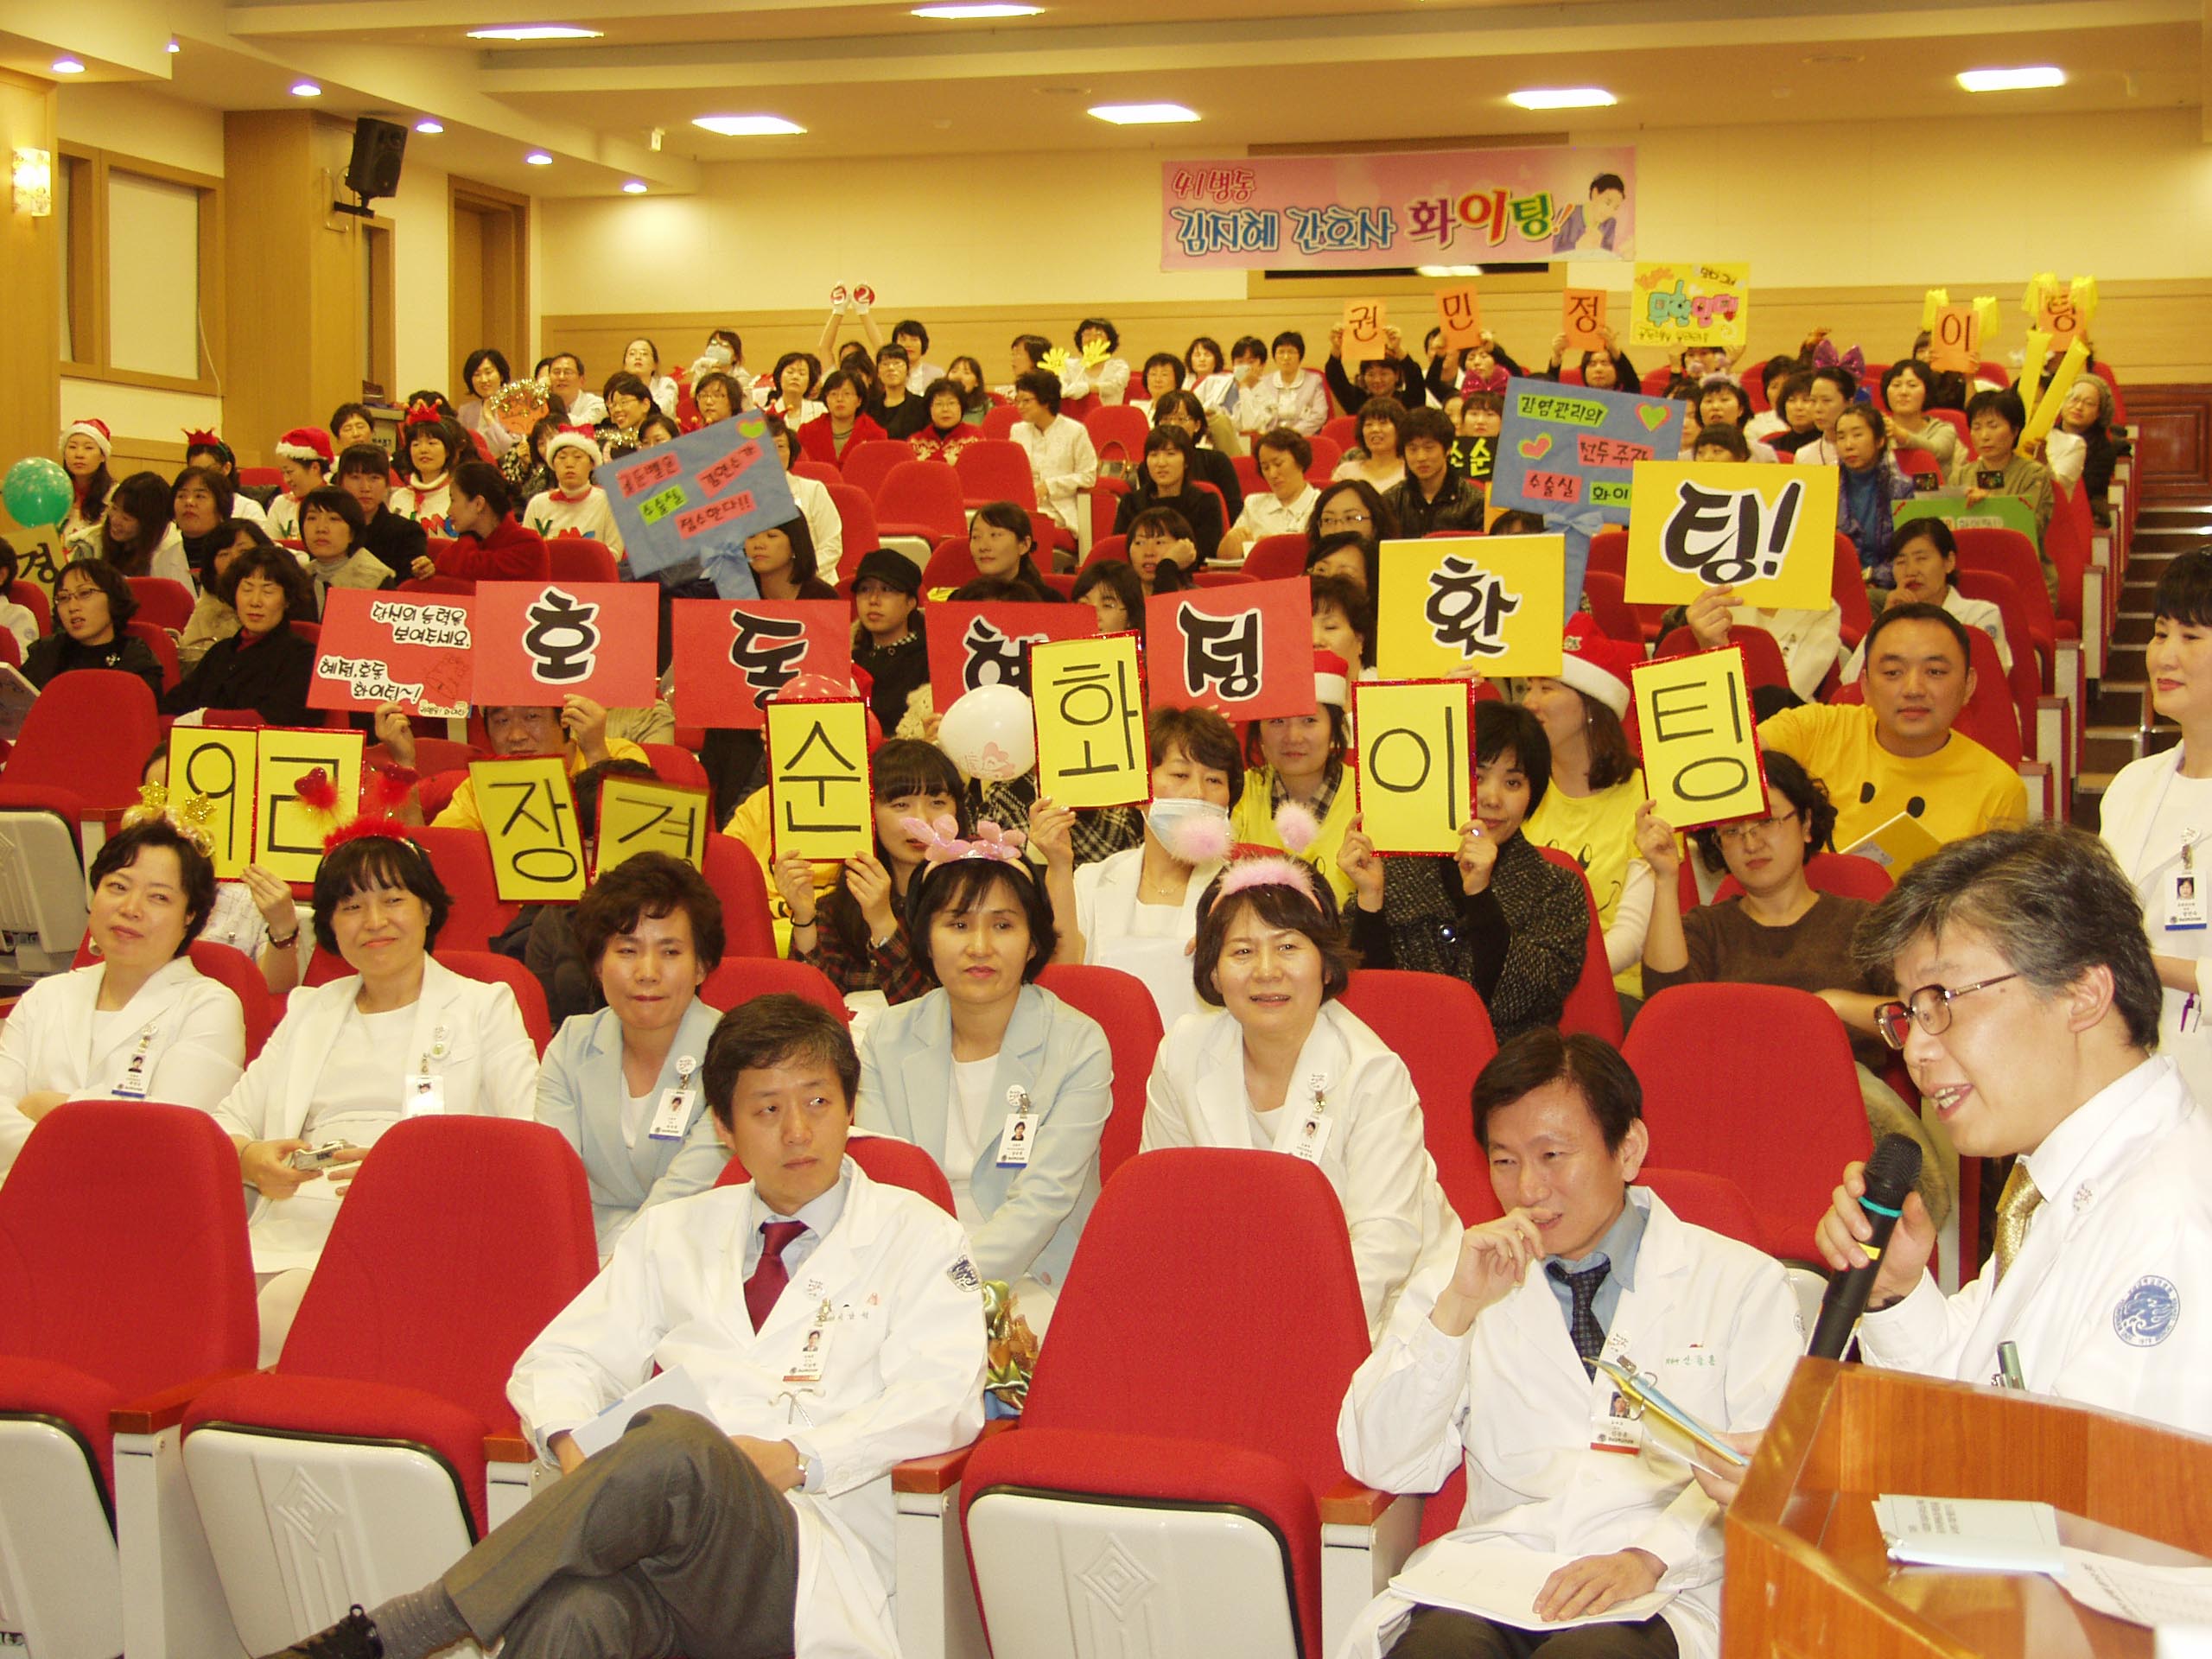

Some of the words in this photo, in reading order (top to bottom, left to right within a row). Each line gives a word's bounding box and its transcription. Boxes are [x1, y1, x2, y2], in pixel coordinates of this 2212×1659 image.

[1173, 168, 1256, 202] 41병동
[1171, 207, 1280, 257] 김지혜
[1286, 205, 1397, 254] 간호사
[1349, 304, 1380, 342] 권
[1442, 292, 1474, 331] 민
[1567, 296, 1600, 334] 정
[1941, 314, 1972, 352] 이
[1530, 474, 1574, 498] 수술실
[1661, 478, 1805, 586] 팅!
[372, 603, 417, 622] 당신의
[421, 607, 465, 626] 능력을
[523, 587, 599, 683] 호
[731, 609, 809, 711] 동
[1052, 659, 1139, 778] 화
[1652, 671, 1749, 802] 팅
[779, 721, 861, 833] 순
[1369, 705, 1457, 831] 이
[488, 780, 577, 882] 장
